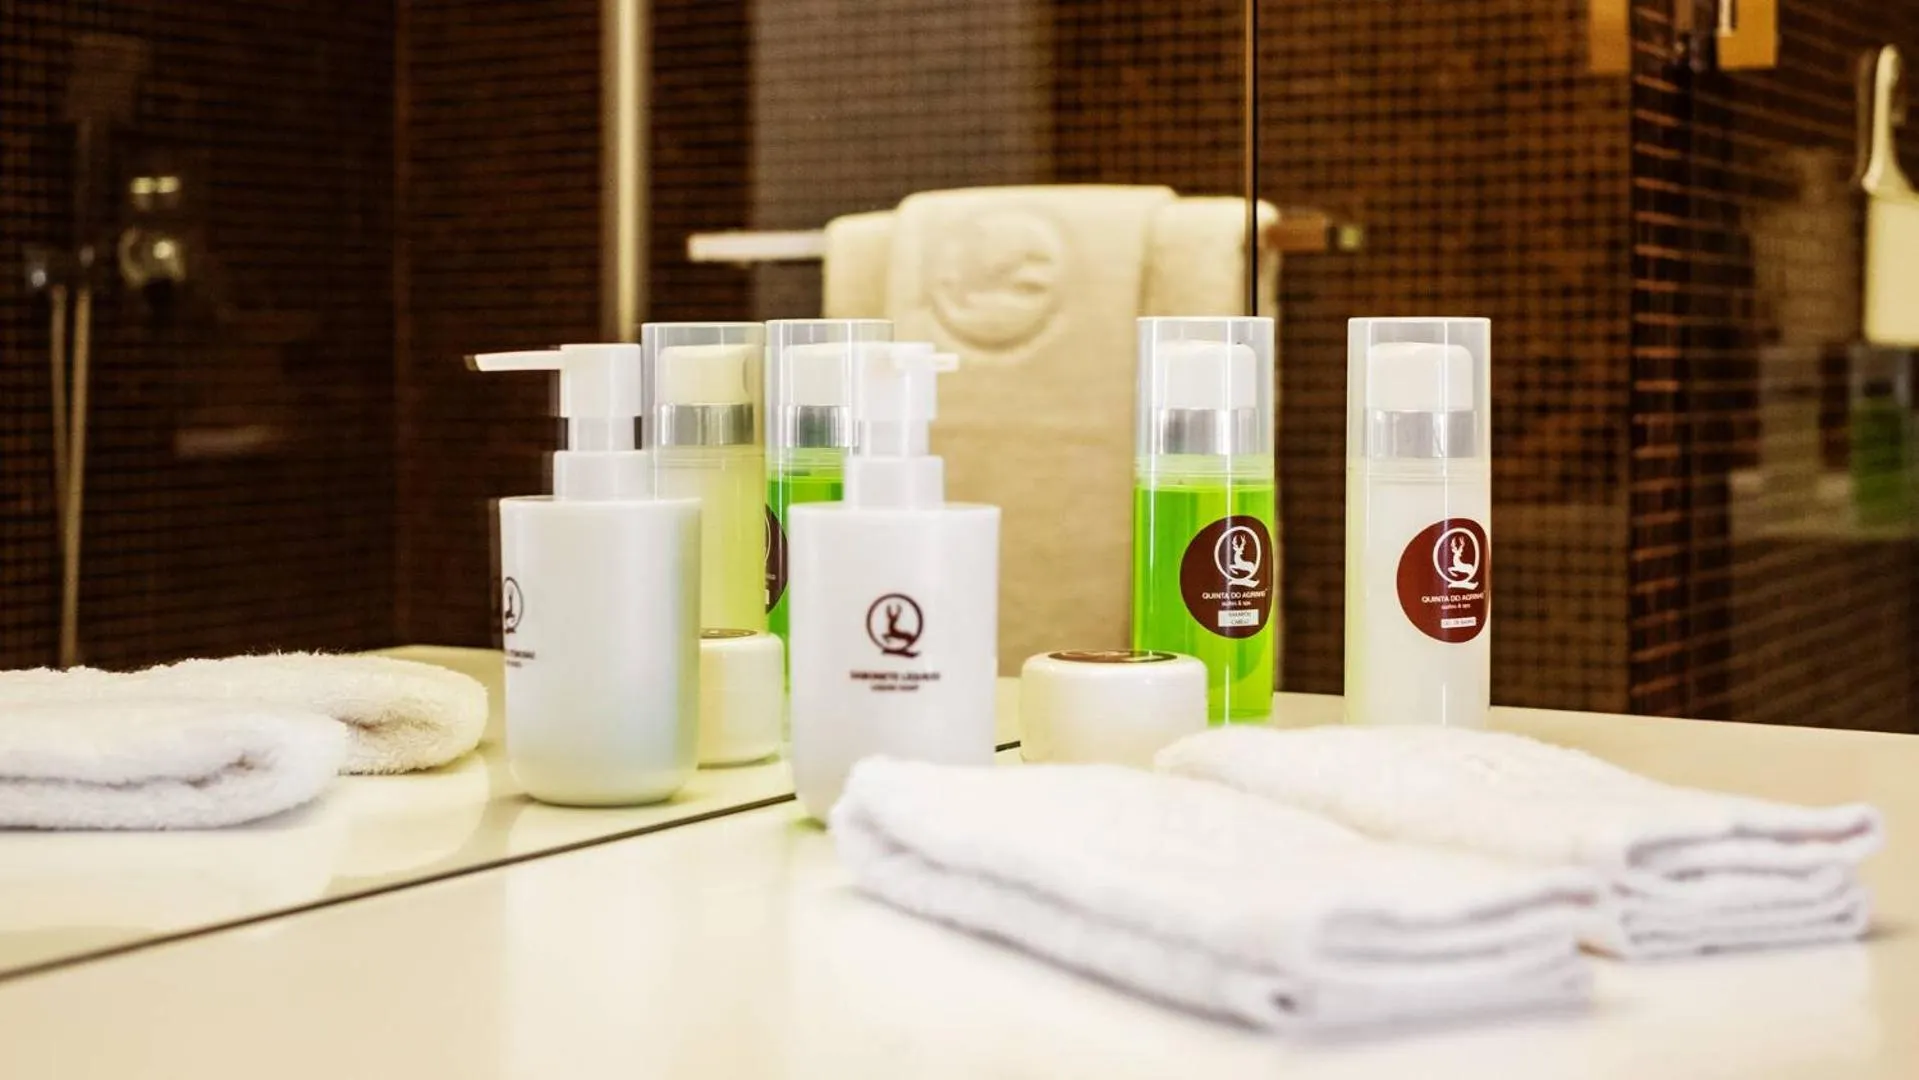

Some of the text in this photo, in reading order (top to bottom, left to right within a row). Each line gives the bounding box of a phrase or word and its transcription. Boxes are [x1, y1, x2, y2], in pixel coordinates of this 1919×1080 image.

[1202, 592, 1229, 600] QUINTA
[1421, 595, 1449, 603] QUINTA
[1450, 594, 1461, 602] DO
